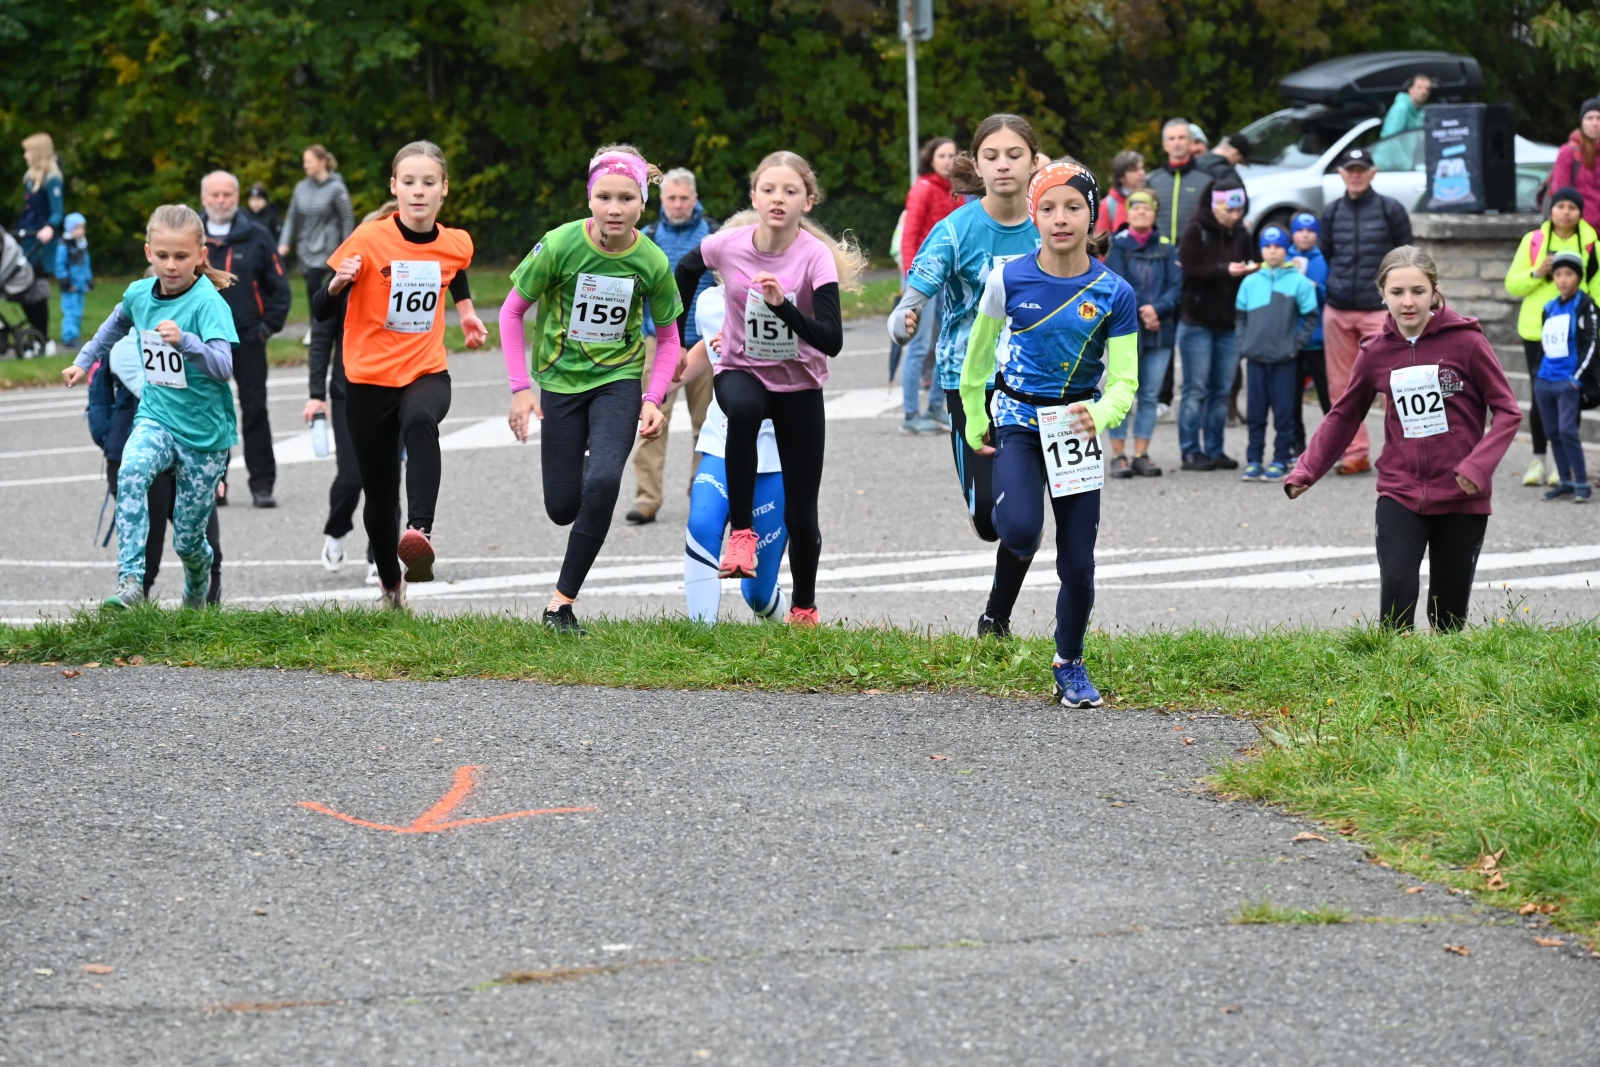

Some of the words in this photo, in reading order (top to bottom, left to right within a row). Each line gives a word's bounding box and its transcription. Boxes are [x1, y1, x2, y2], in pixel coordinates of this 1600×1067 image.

[392, 291, 437, 312] 160
[575, 302, 627, 325] 159
[747, 318, 794, 340] 151
[143, 348, 183, 374] 210
[1397, 391, 1444, 417] 102
[1057, 430, 1073, 438] CENA
[1046, 435, 1103, 468] 134
[1055, 469, 1076, 477] MONIKA
